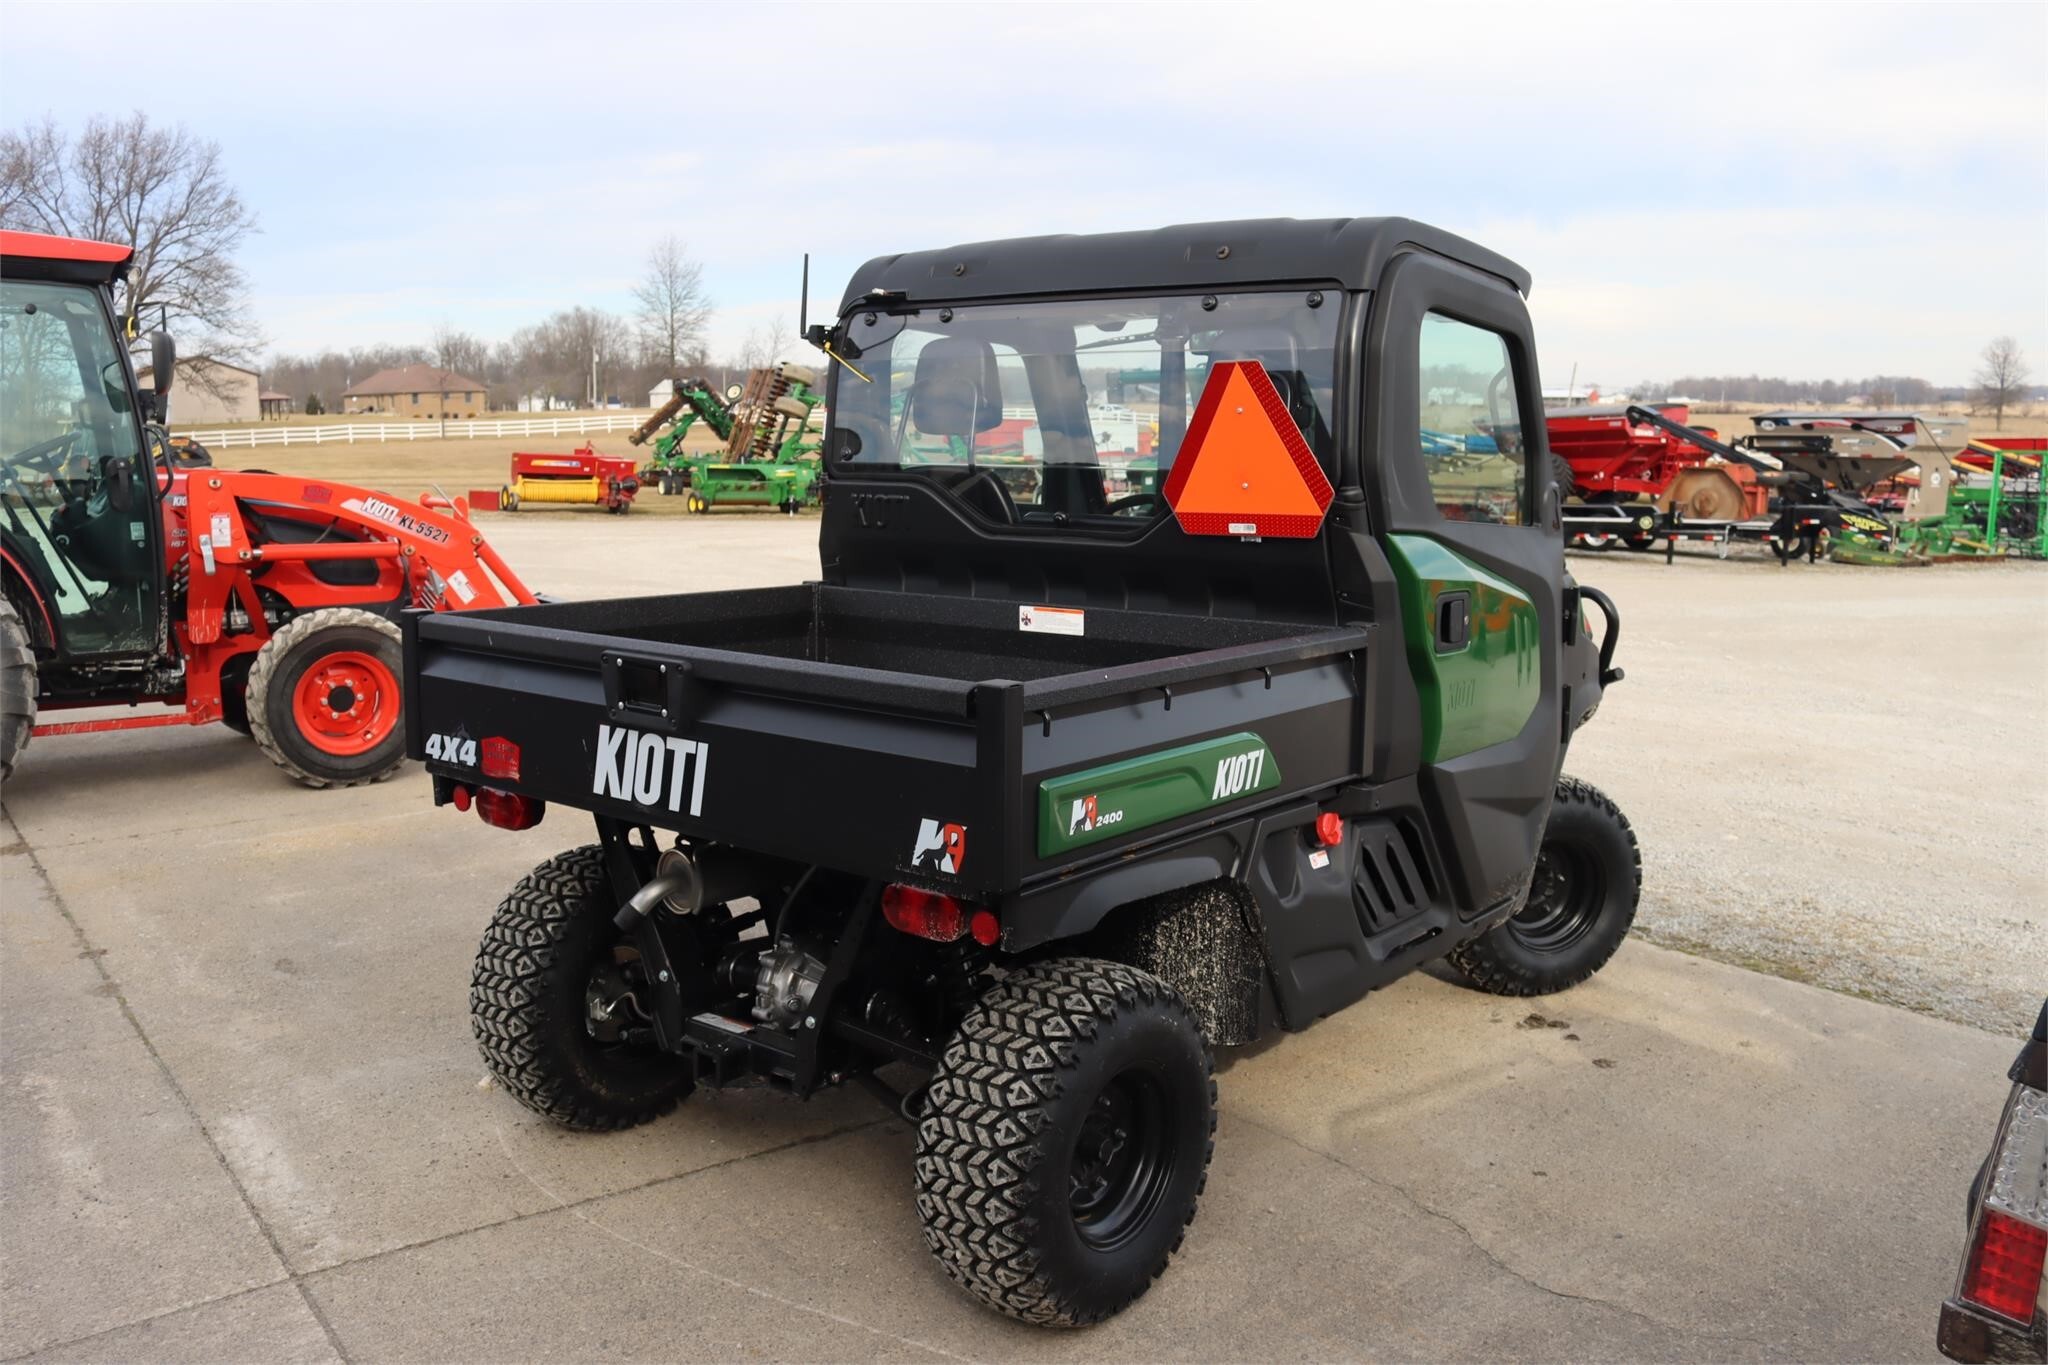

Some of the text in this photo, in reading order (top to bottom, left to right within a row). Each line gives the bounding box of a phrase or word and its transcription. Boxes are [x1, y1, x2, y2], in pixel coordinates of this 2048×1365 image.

[360, 496, 400, 523] KIOTI
[1447, 678, 1477, 712] KIOTI
[425, 733, 477, 767] 4X4
[592, 723, 709, 817] KIOTI
[1212, 749, 1264, 800] KIOTI
[1095, 809, 1124, 827] 2400
[911, 817, 968, 875] K9
